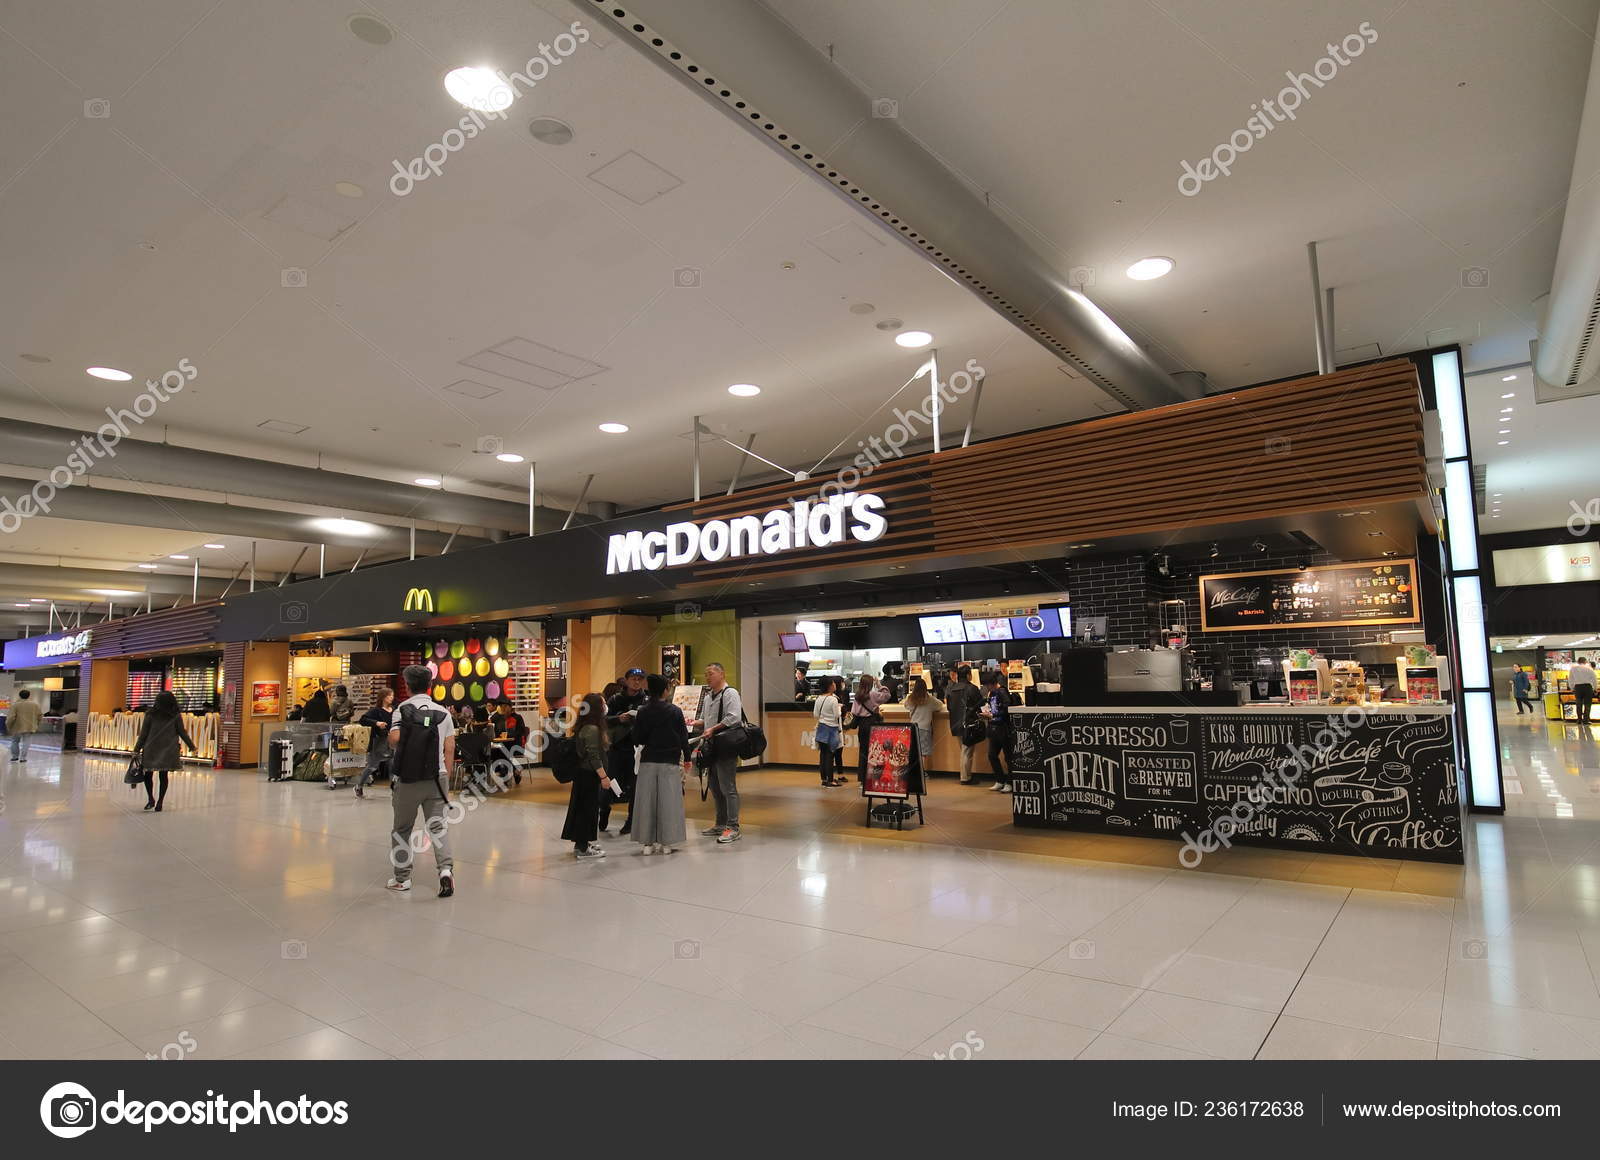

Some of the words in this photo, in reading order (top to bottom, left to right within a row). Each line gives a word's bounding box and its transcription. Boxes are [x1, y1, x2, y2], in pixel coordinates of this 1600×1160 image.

[606, 492, 888, 575] McDonald's
[1071, 726, 1167, 747] ESPRESSO
[1210, 723, 1236, 743] KISS
[1243, 724, 1294, 745] GOODBYE
[1128, 757, 1191, 769] ROASTED
[1208, 745, 1275, 770] Monday
[1044, 751, 1119, 794] TREAT
[1051, 791, 1116, 810] YOURSELF
[1203, 784, 1313, 805] CAPPUCCINO
[1220, 813, 1277, 838] Proudly
[1367, 820, 1458, 850] Coffee
